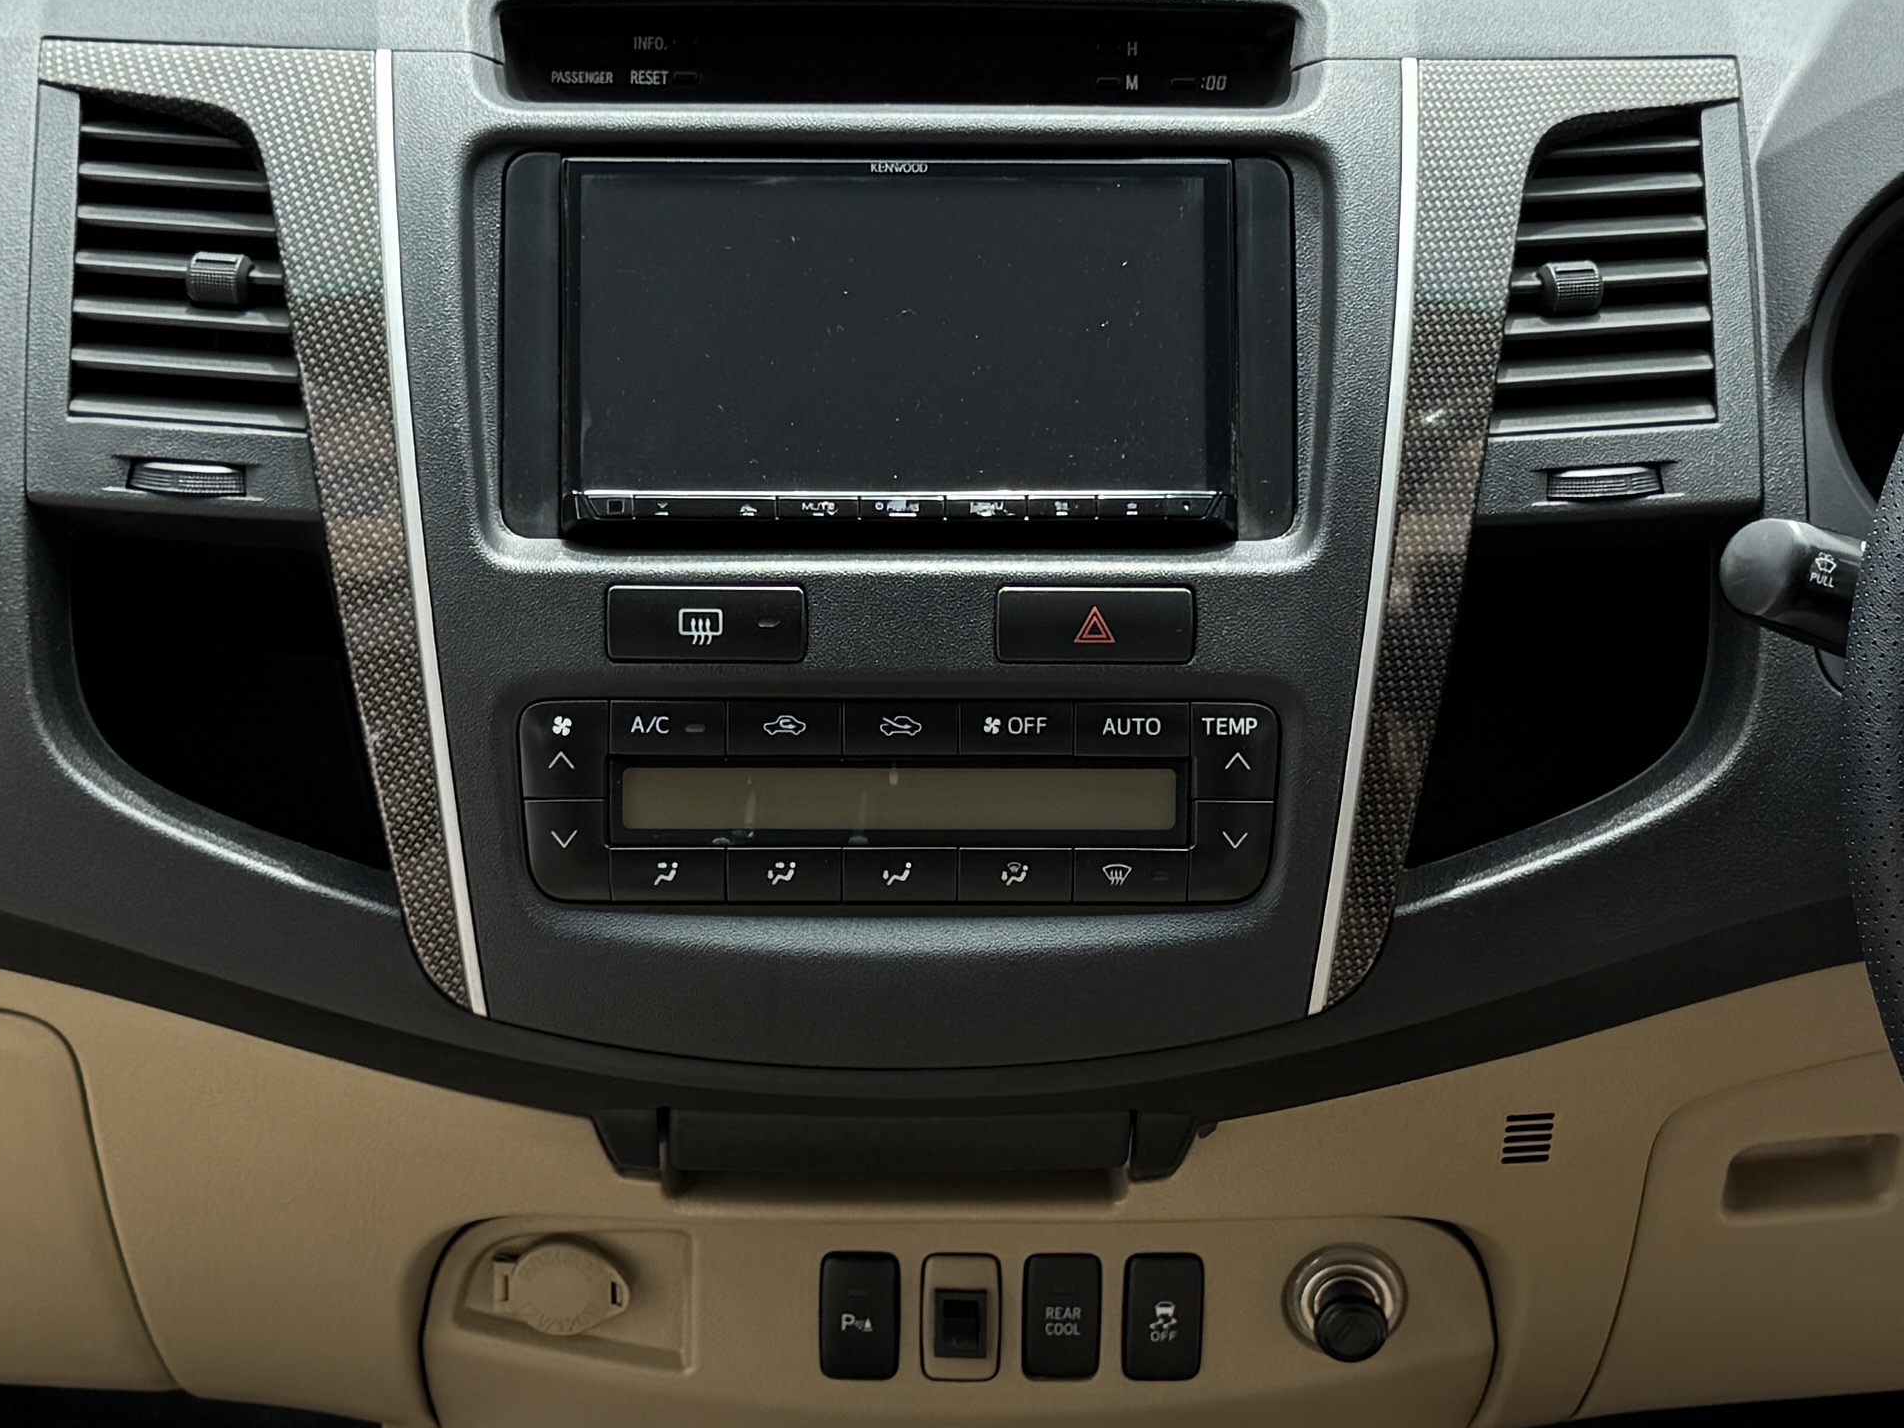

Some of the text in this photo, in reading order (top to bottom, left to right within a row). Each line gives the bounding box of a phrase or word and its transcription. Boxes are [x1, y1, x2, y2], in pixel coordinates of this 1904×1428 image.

[1127, 41, 1138, 56] H
[551, 70, 669, 85] PASSENGER RESET
[1125, 74, 1139, 90] M
[870, 163, 928, 173] KENWOOD
[1809, 571, 1834, 589] PULL
[631, 716, 670, 737] A/C
[1007, 715, 1047, 736] OFF
[1101, 716, 1162, 738] AUTO
[1201, 716, 1258, 738] TEMP
[1045, 1306, 1081, 1320] REAR
[1045, 1322, 1081, 1336] COOL
[1149, 1330, 1177, 1343] OFF
